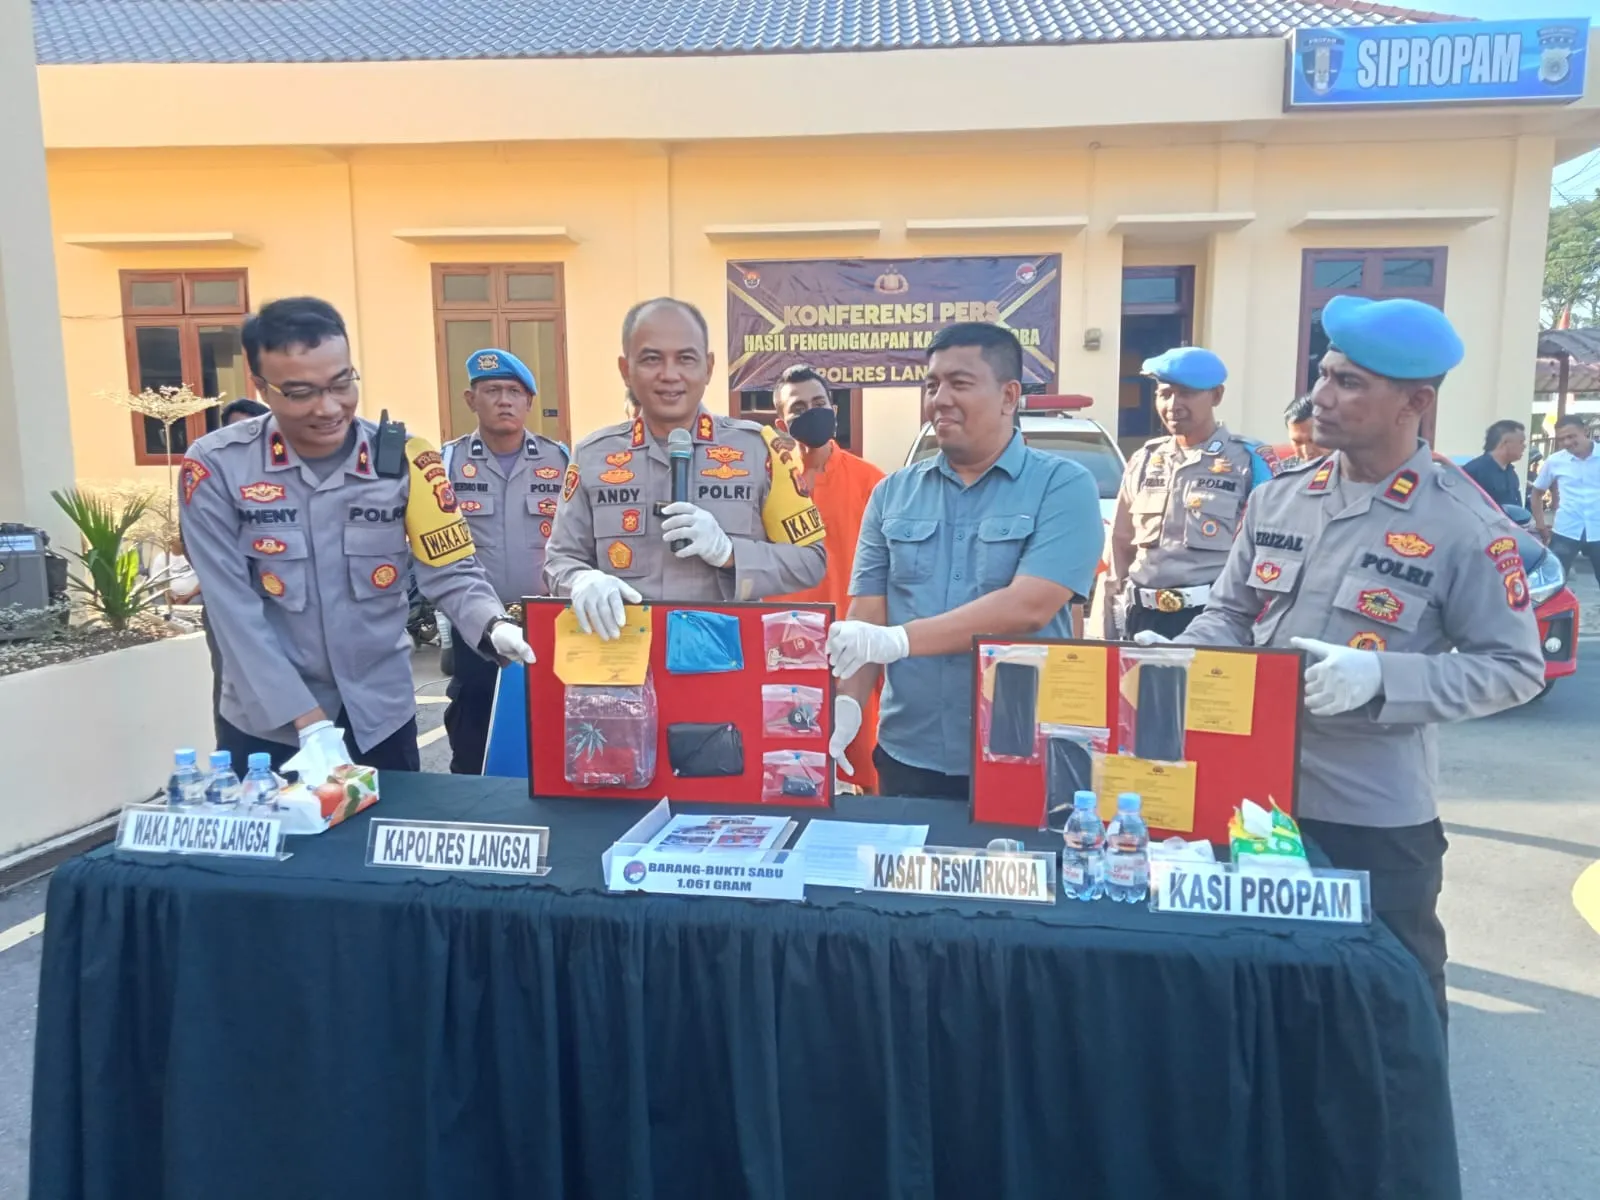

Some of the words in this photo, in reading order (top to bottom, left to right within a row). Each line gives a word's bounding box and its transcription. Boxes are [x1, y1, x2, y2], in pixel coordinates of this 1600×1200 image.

[1356, 33, 1522, 89] SIPROPAM
[782, 303, 933, 327] KONFERENSI
[939, 301, 1000, 323] PERS
[744, 334, 788, 352] HASIL
[790, 331, 909, 351] PENGUNGKAPAN
[912, 331, 934, 348] KA
[816, 366, 886, 383] POLRES
[890, 365, 930, 381] LAN
[597, 488, 640, 503] ANDY
[698, 484, 751, 500] POLRI
[1197, 479, 1236, 493] POLRI
[349, 506, 405, 523] POLR
[788, 514, 810, 539] KA
[426, 527, 461, 555] WAKA
[1360, 552, 1434, 588] POLRI
[134, 812, 169, 846] WAKA
[171, 815, 219, 850] POLRES
[221, 819, 272, 855] LANGSA
[382, 828, 466, 867] KAPOLRES
[468, 833, 532, 871] LANGSA
[648, 862, 746, 877] BARANG-BUKTI
[748, 867, 784, 879] SABU
[873, 851, 928, 889] KASAT
[929, 854, 1039, 898] RESNARKOBA
[677, 877, 711, 889] 1.061
[713, 879, 752, 892] GRAM
[1169, 871, 1232, 912] KASI
[1241, 876, 1352, 920] PROPAM
